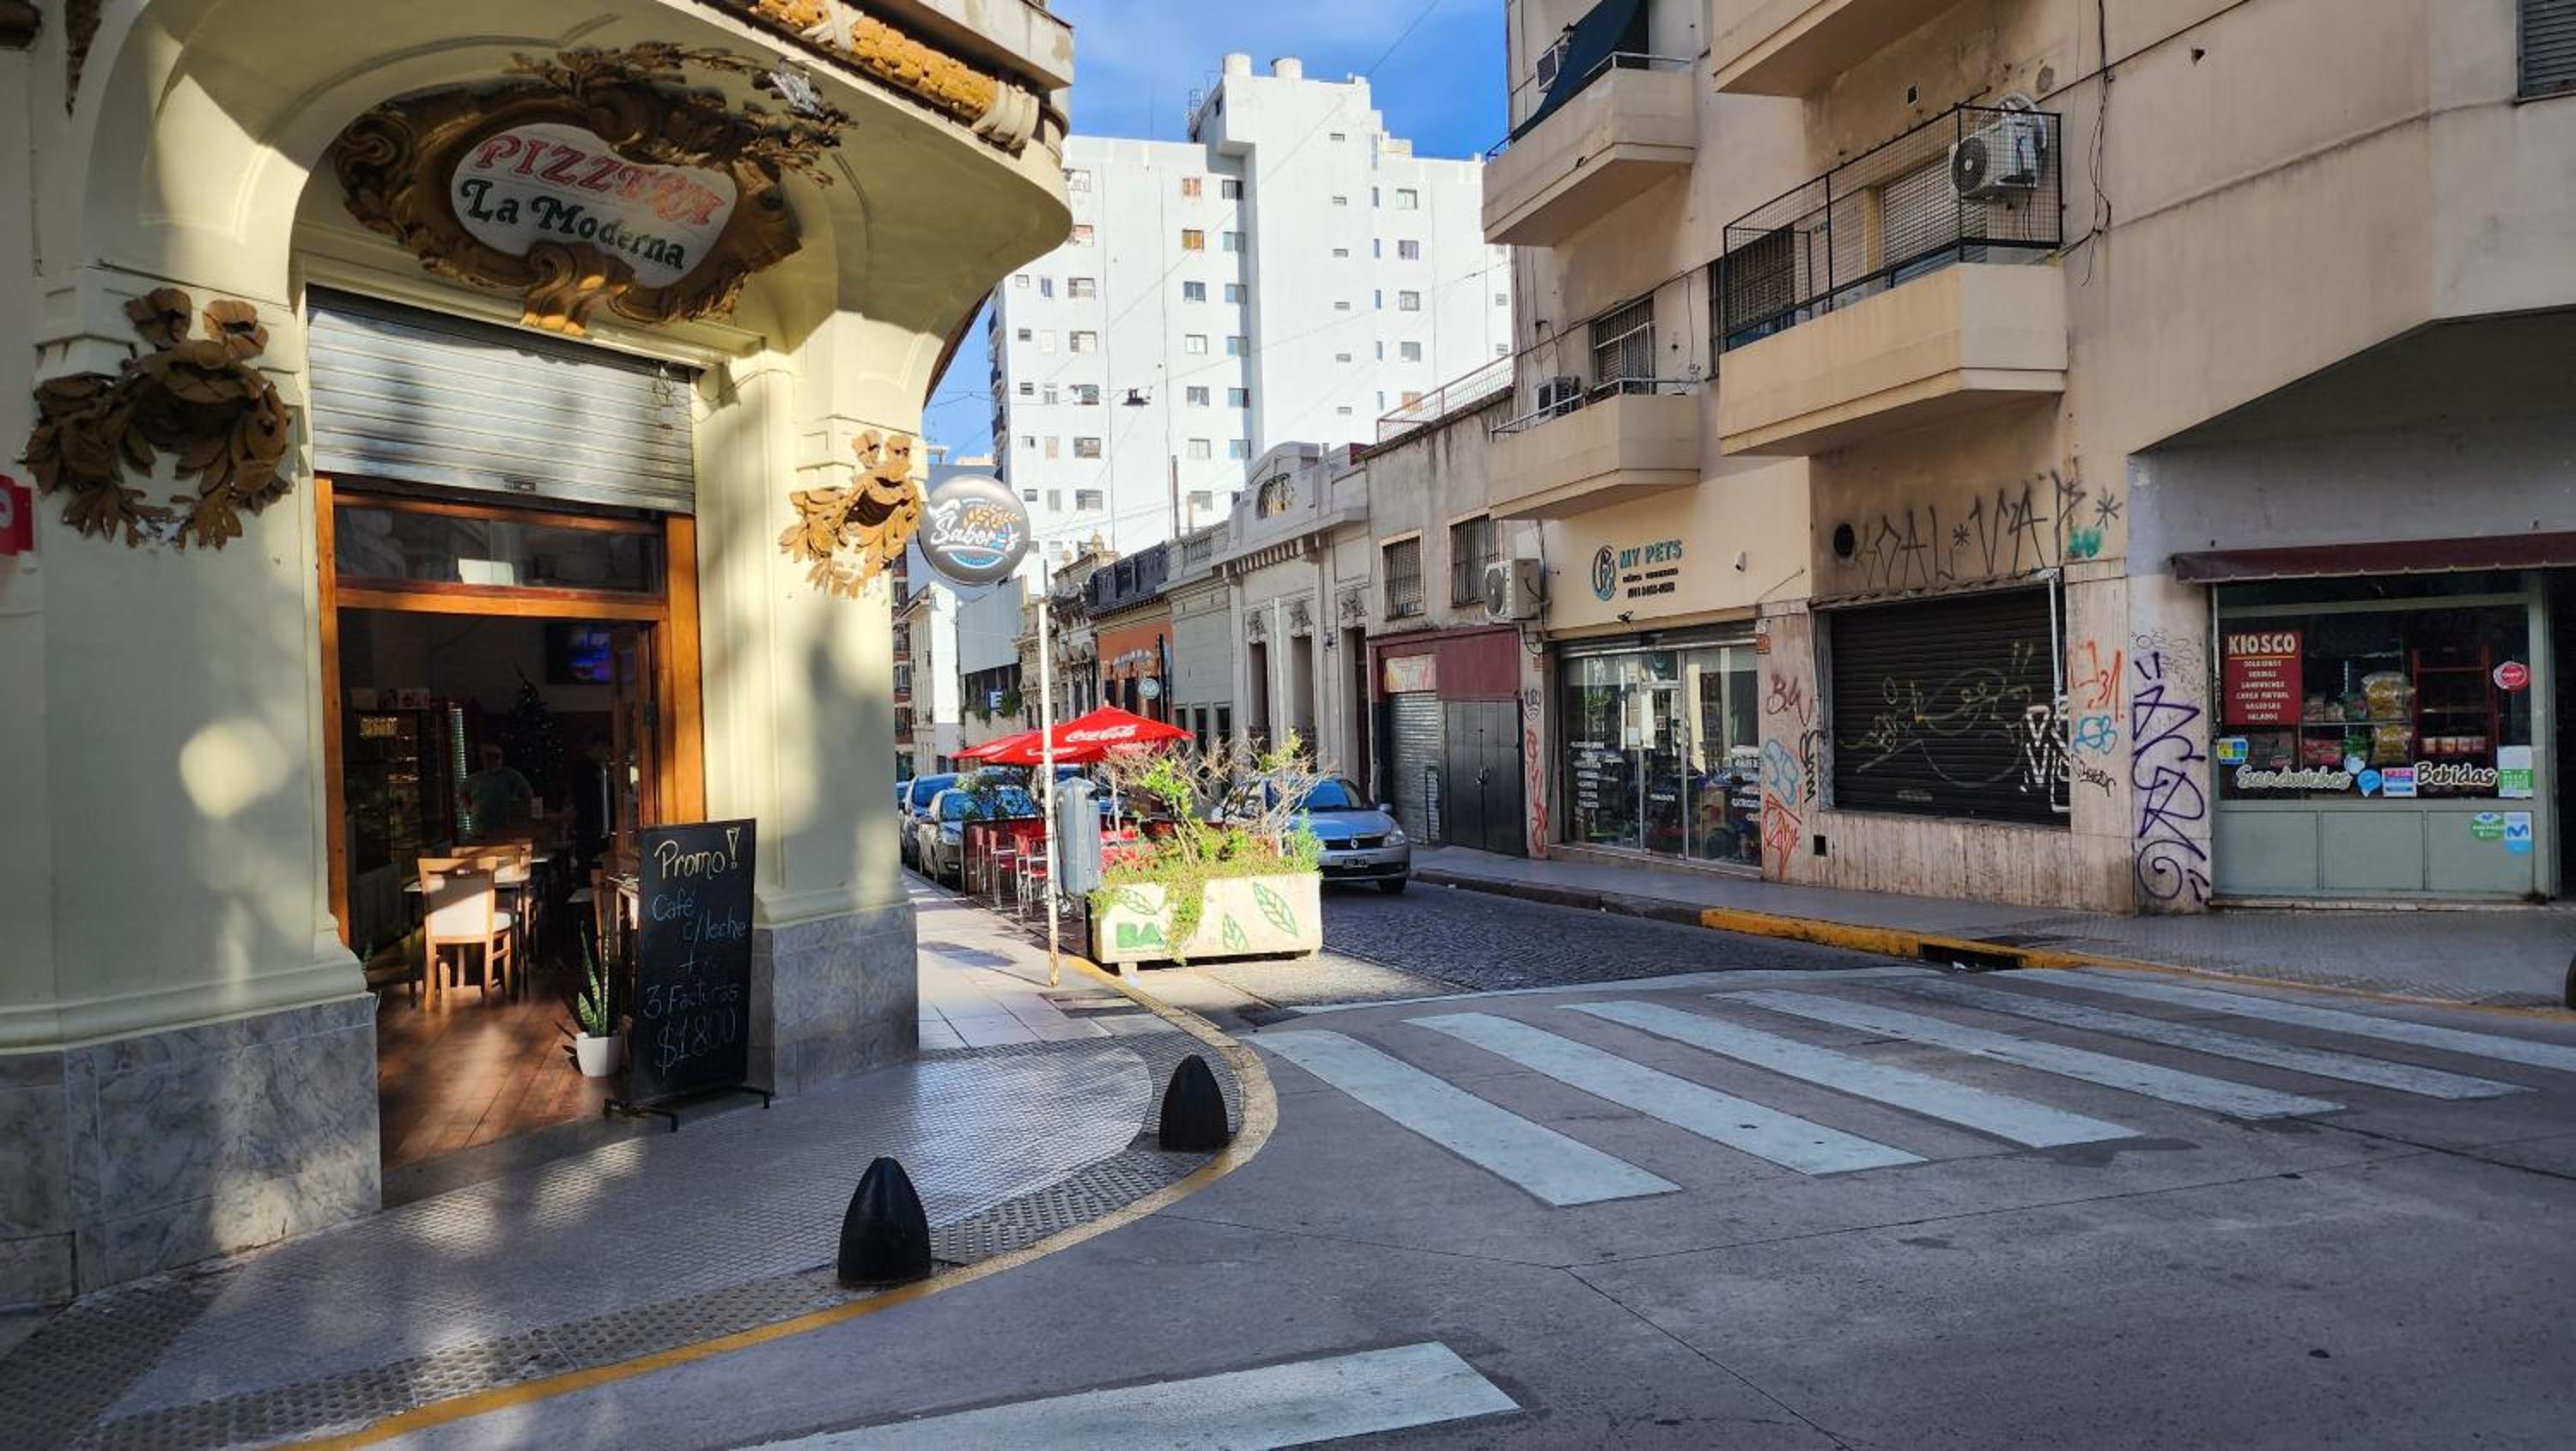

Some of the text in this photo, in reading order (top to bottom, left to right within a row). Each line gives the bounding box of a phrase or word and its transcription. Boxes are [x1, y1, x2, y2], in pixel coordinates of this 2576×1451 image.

[460, 178, 685, 270] La Moderna
[1620, 539, 1683, 569] MY PETS
[2227, 633, 2296, 655] KIOSCO
[2415, 761, 2498, 787] Bebidas
[643, 985, 662, 1018] 3
